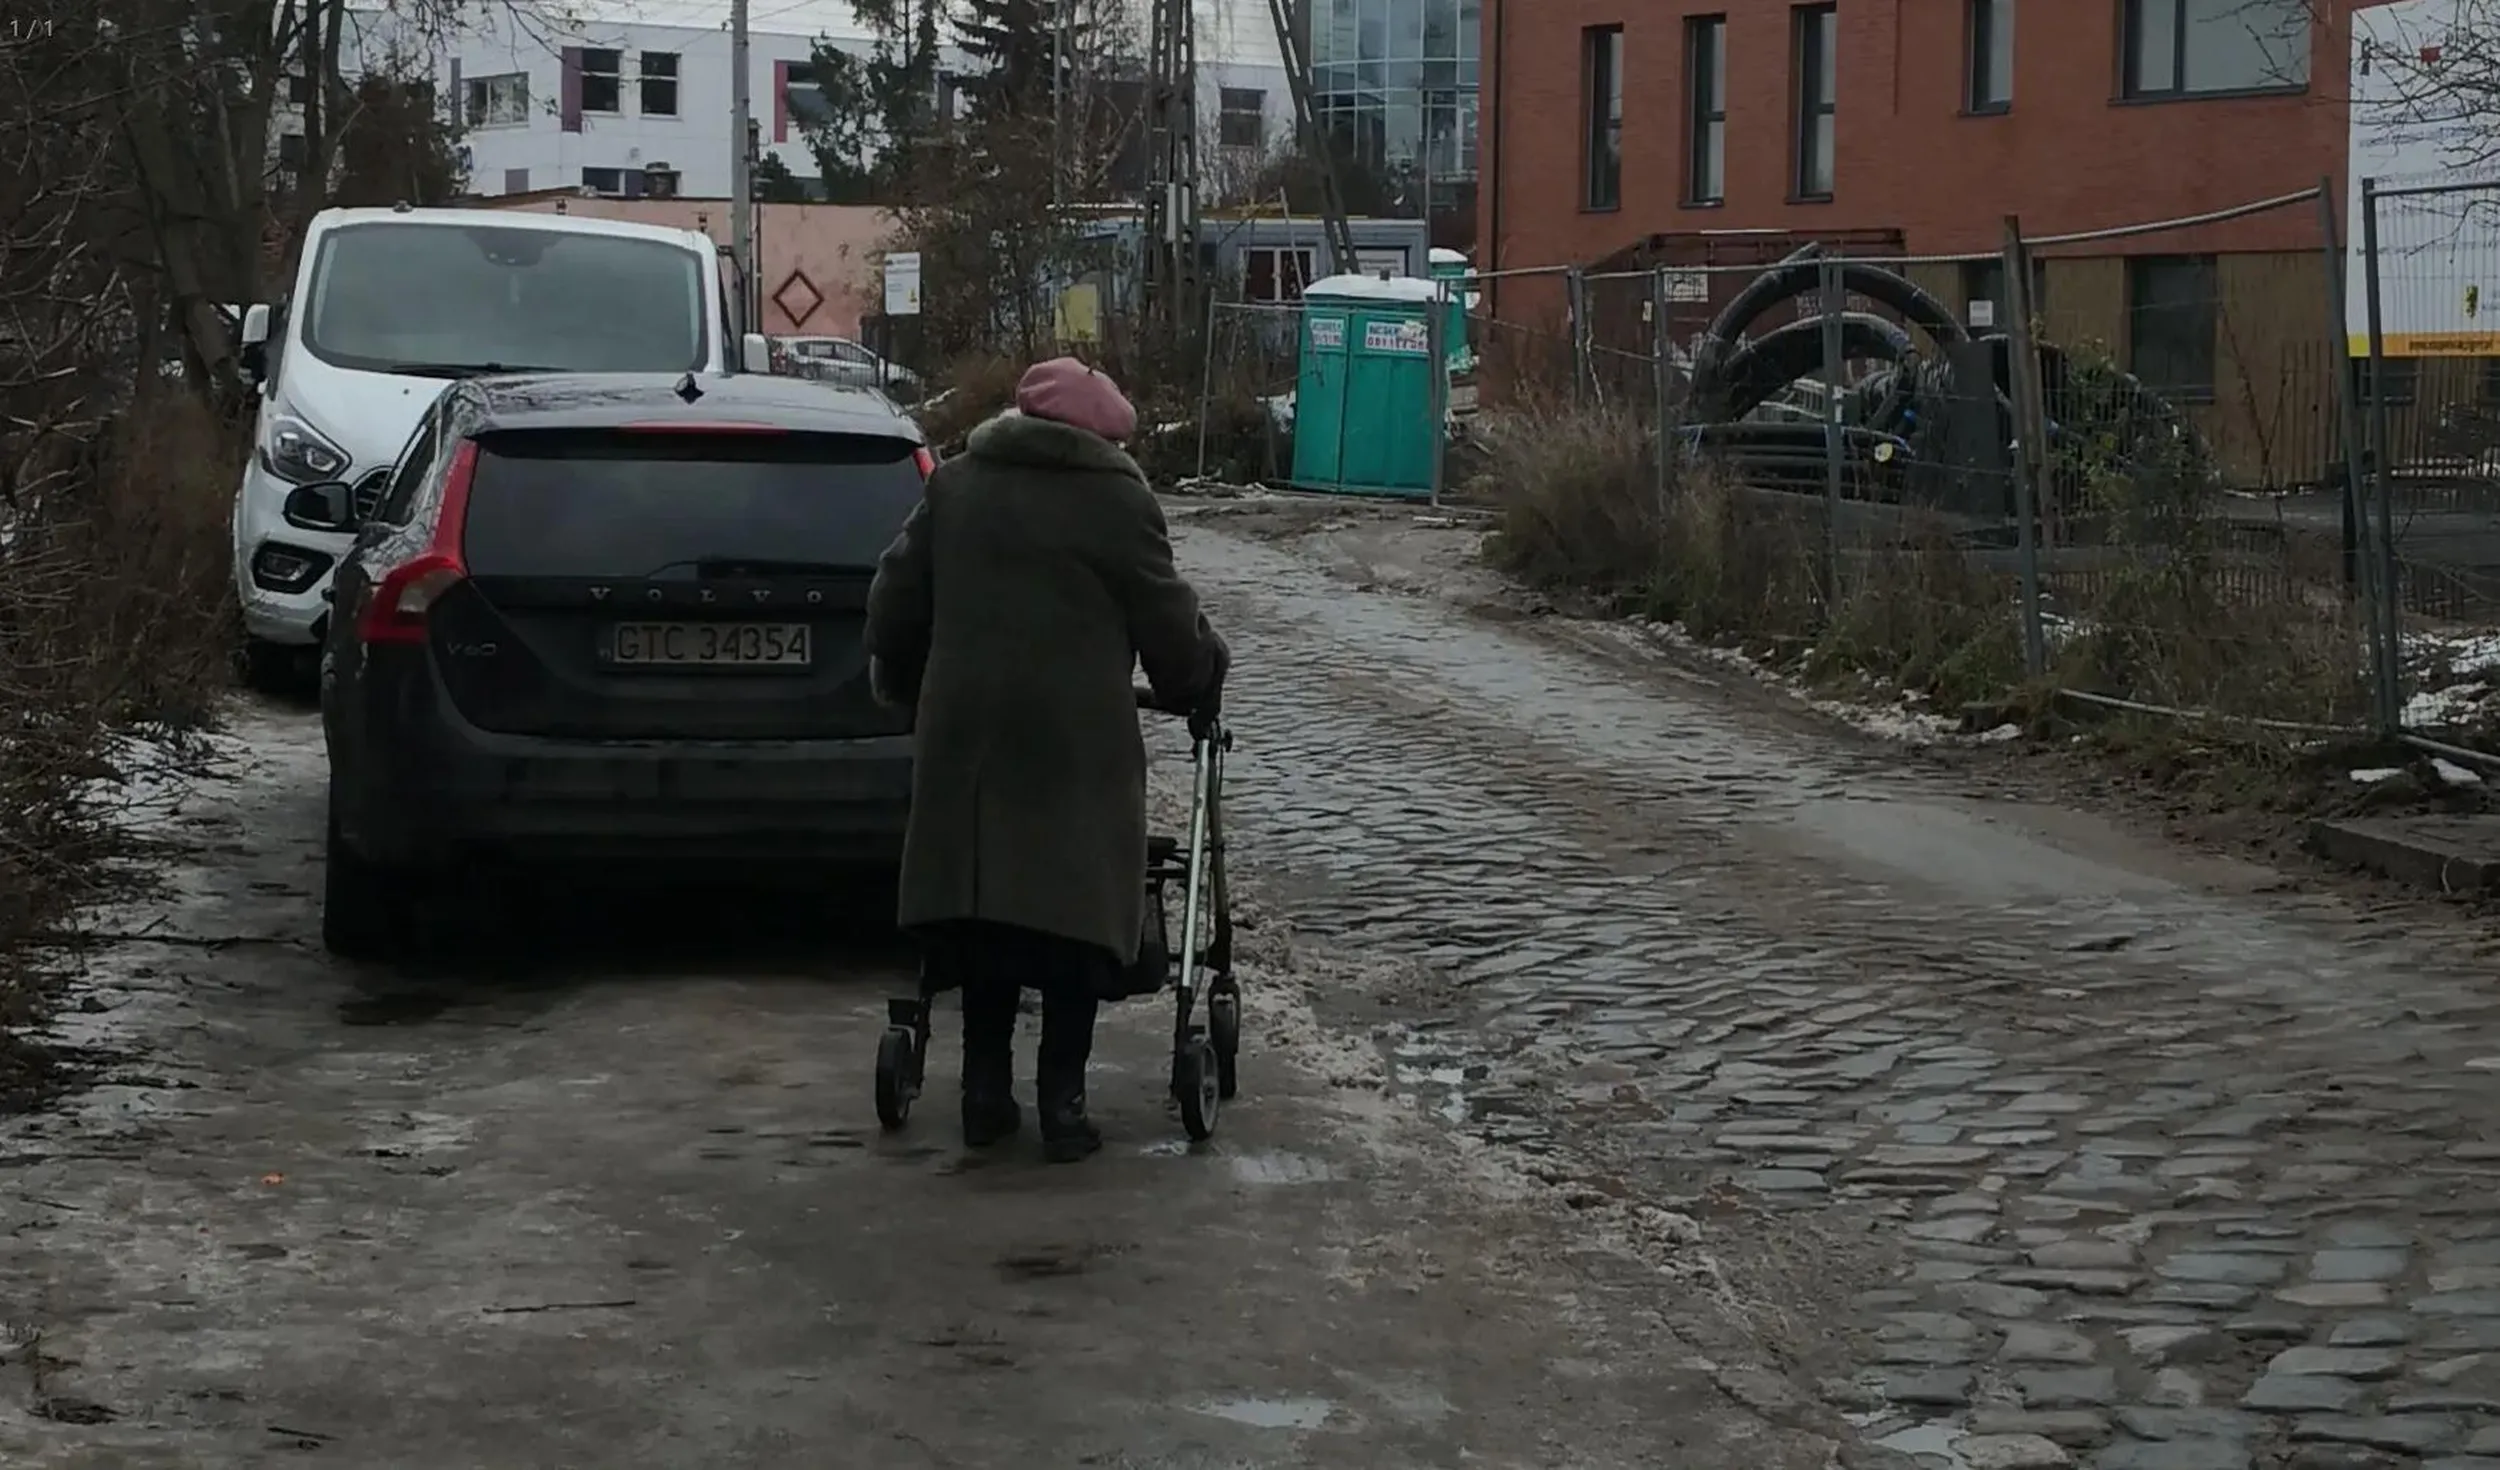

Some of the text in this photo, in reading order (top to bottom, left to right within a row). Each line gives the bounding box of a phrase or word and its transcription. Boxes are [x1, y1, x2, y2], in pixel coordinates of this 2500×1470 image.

[590, 587, 822, 602] VOLVO
[617, 625, 806, 662] GTC 34354
